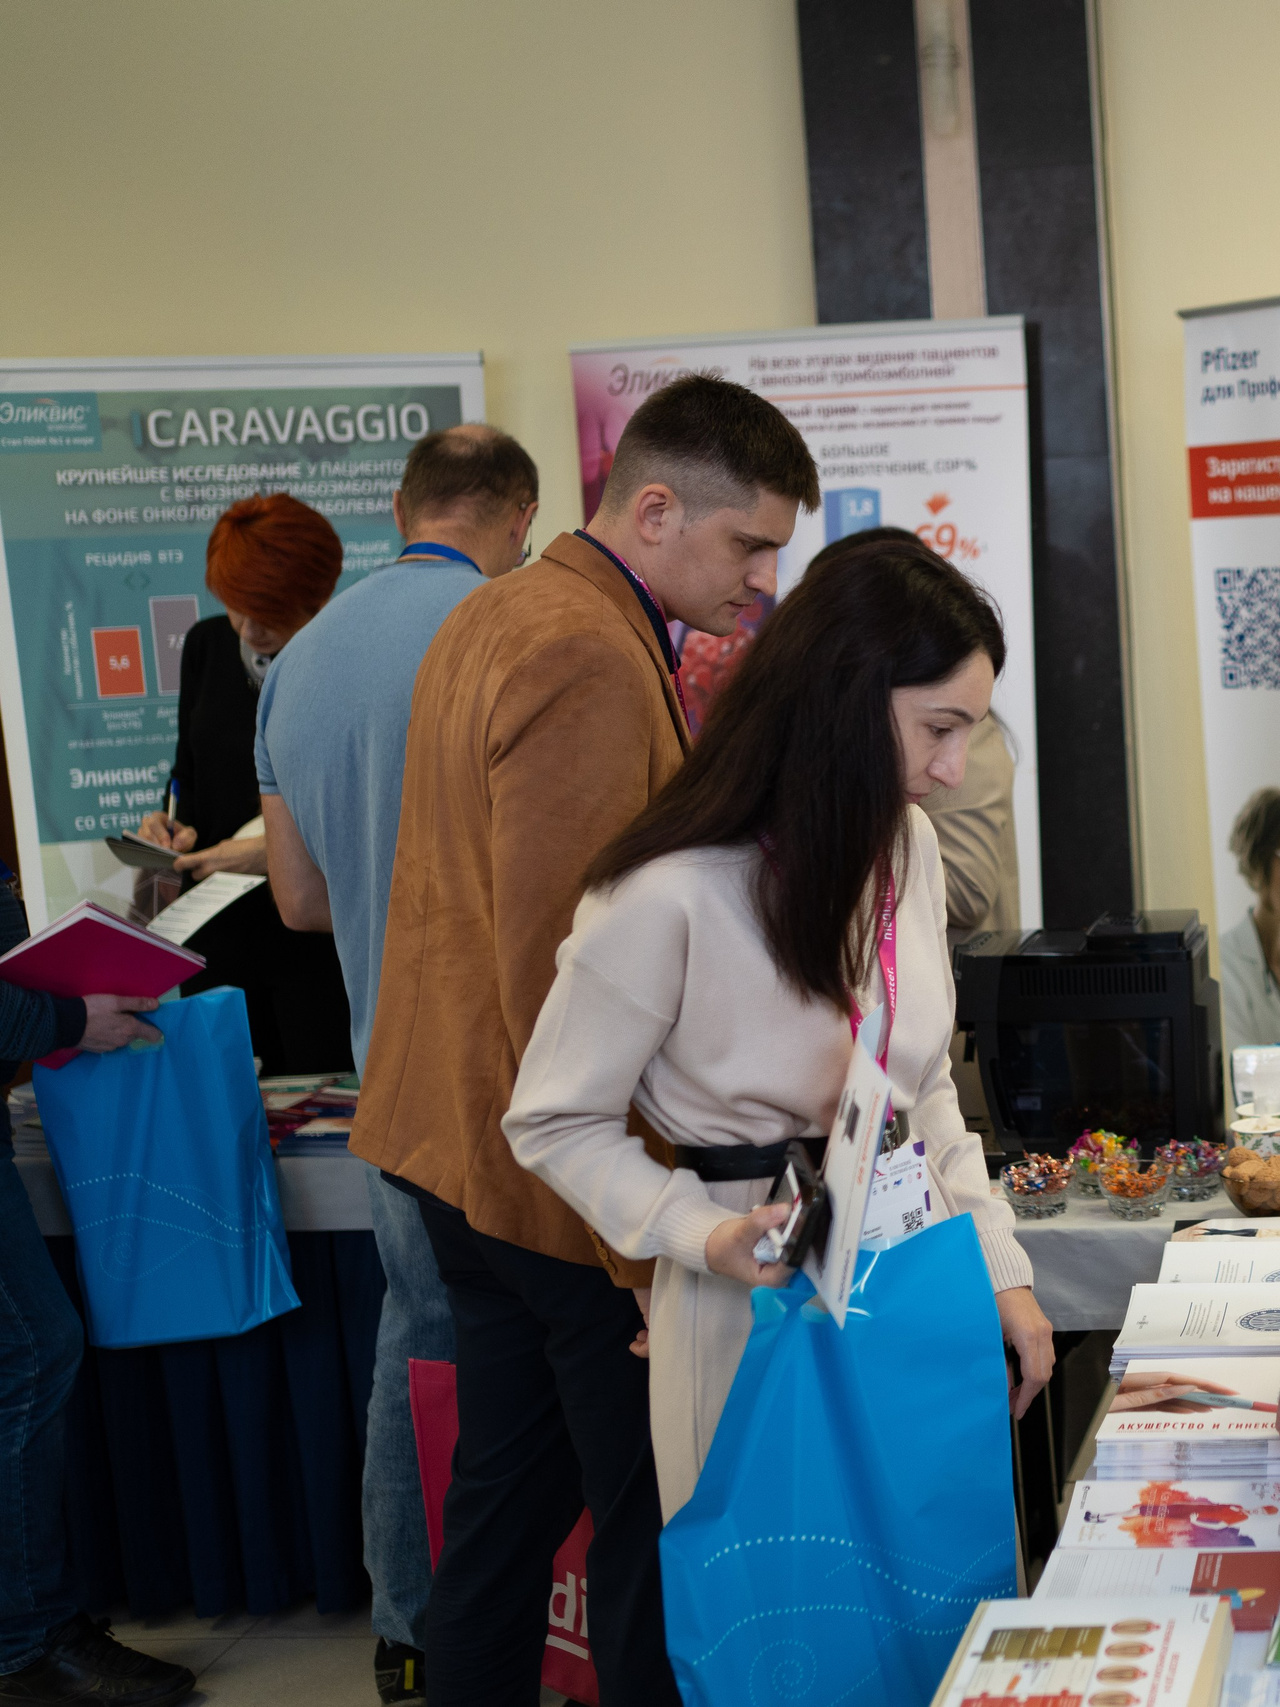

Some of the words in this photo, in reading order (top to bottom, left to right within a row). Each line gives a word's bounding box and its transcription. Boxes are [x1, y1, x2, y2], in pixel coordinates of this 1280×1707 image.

[1201, 347, 1259, 373] Pfizer
[1202, 385, 1234, 406] для
[147, 403, 430, 447] CARAVAGGIO
[56, 464, 168, 486] КРУПНЕЙШЕЕ
[172, 462, 300, 482] ИССЛЕДОВАНИЕ
[321, 459, 407, 477] ПАЦИЕНТО
[1208, 487, 1232, 504] на
[65, 509, 88, 525] НА
[92, 507, 139, 524] ФОНЕ
[85, 551, 151, 567] РЕЦИДИВ
[158, 550, 184, 563] ВТЭ
[98, 792, 121, 808] не
[74, 816, 96, 831] со
[1118, 1422, 1204, 1431] АКУШЕРСТВО
[1212, 1422, 1220, 1430] И
[1228, 1421, 1277, 1430] ГИНЕКО
[549, 1570, 588, 1639] di
